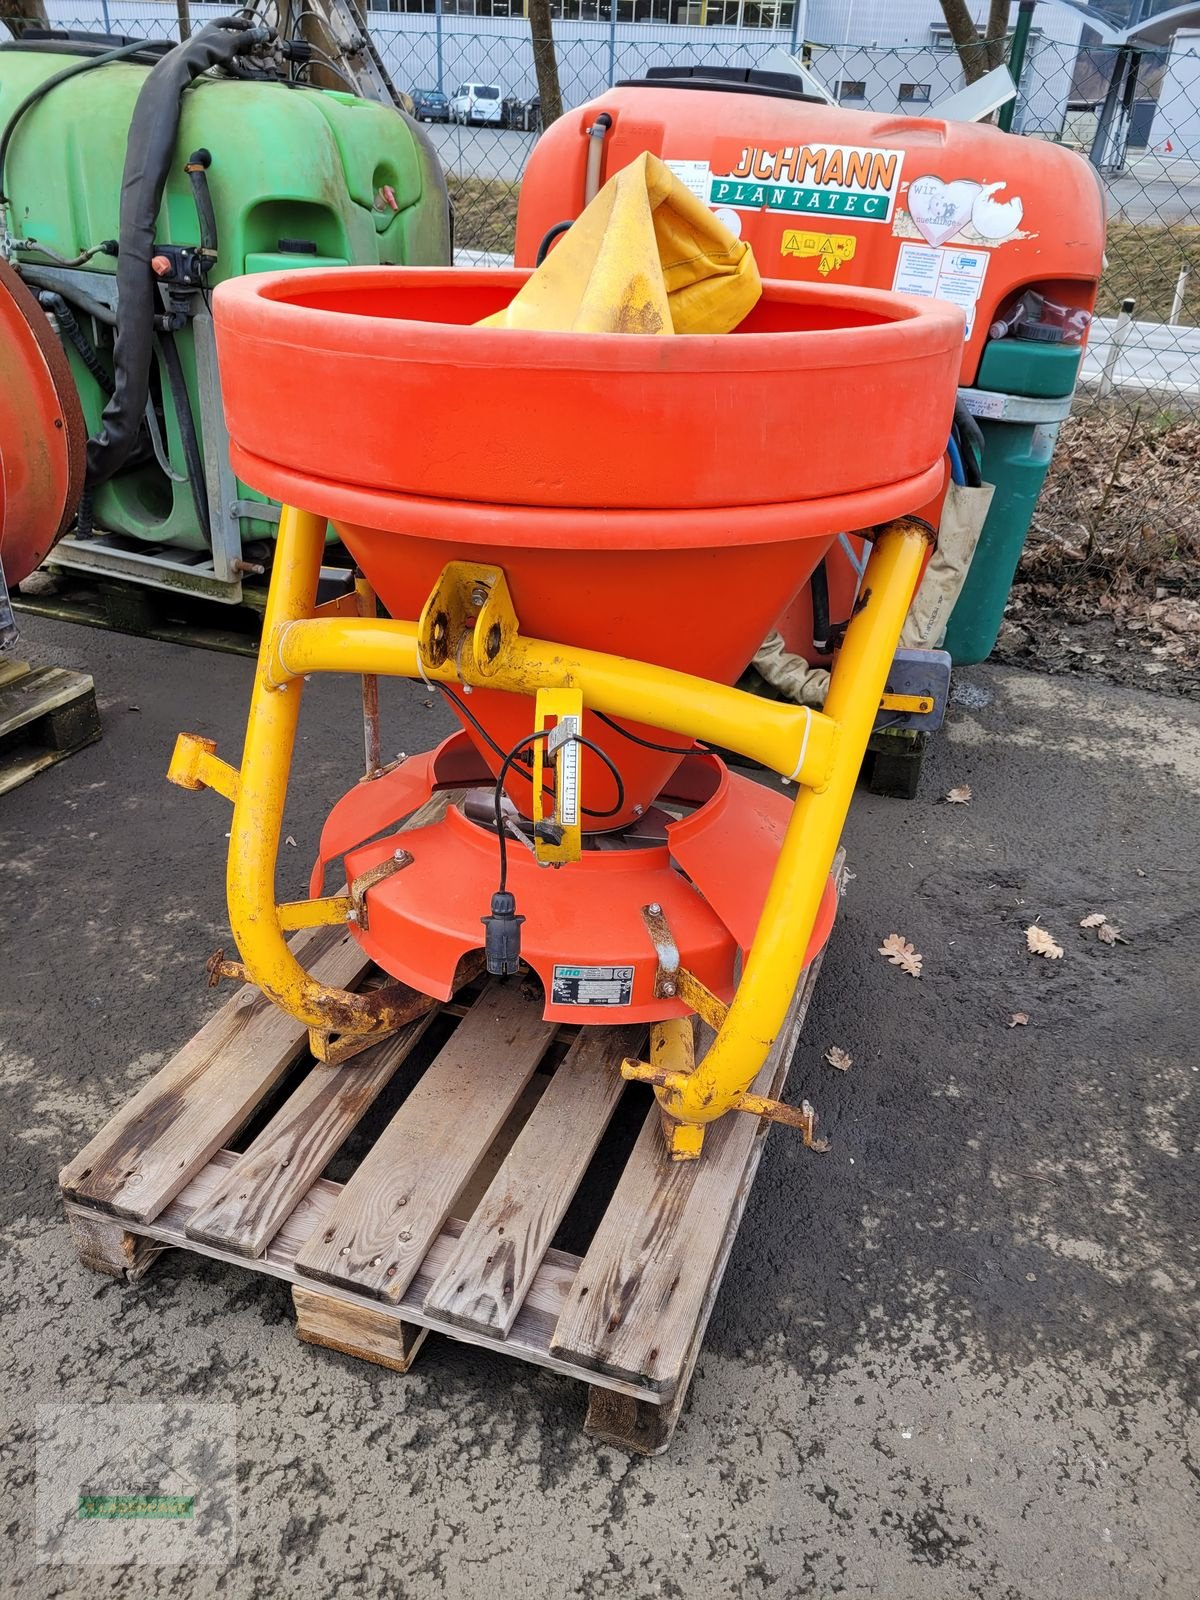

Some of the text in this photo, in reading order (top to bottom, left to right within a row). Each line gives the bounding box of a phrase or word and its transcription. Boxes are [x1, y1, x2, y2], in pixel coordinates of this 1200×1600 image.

[713, 145, 898, 191] OCHMANN
[717, 183, 880, 213] PLANTATEC
[913, 183, 936, 195] wir
